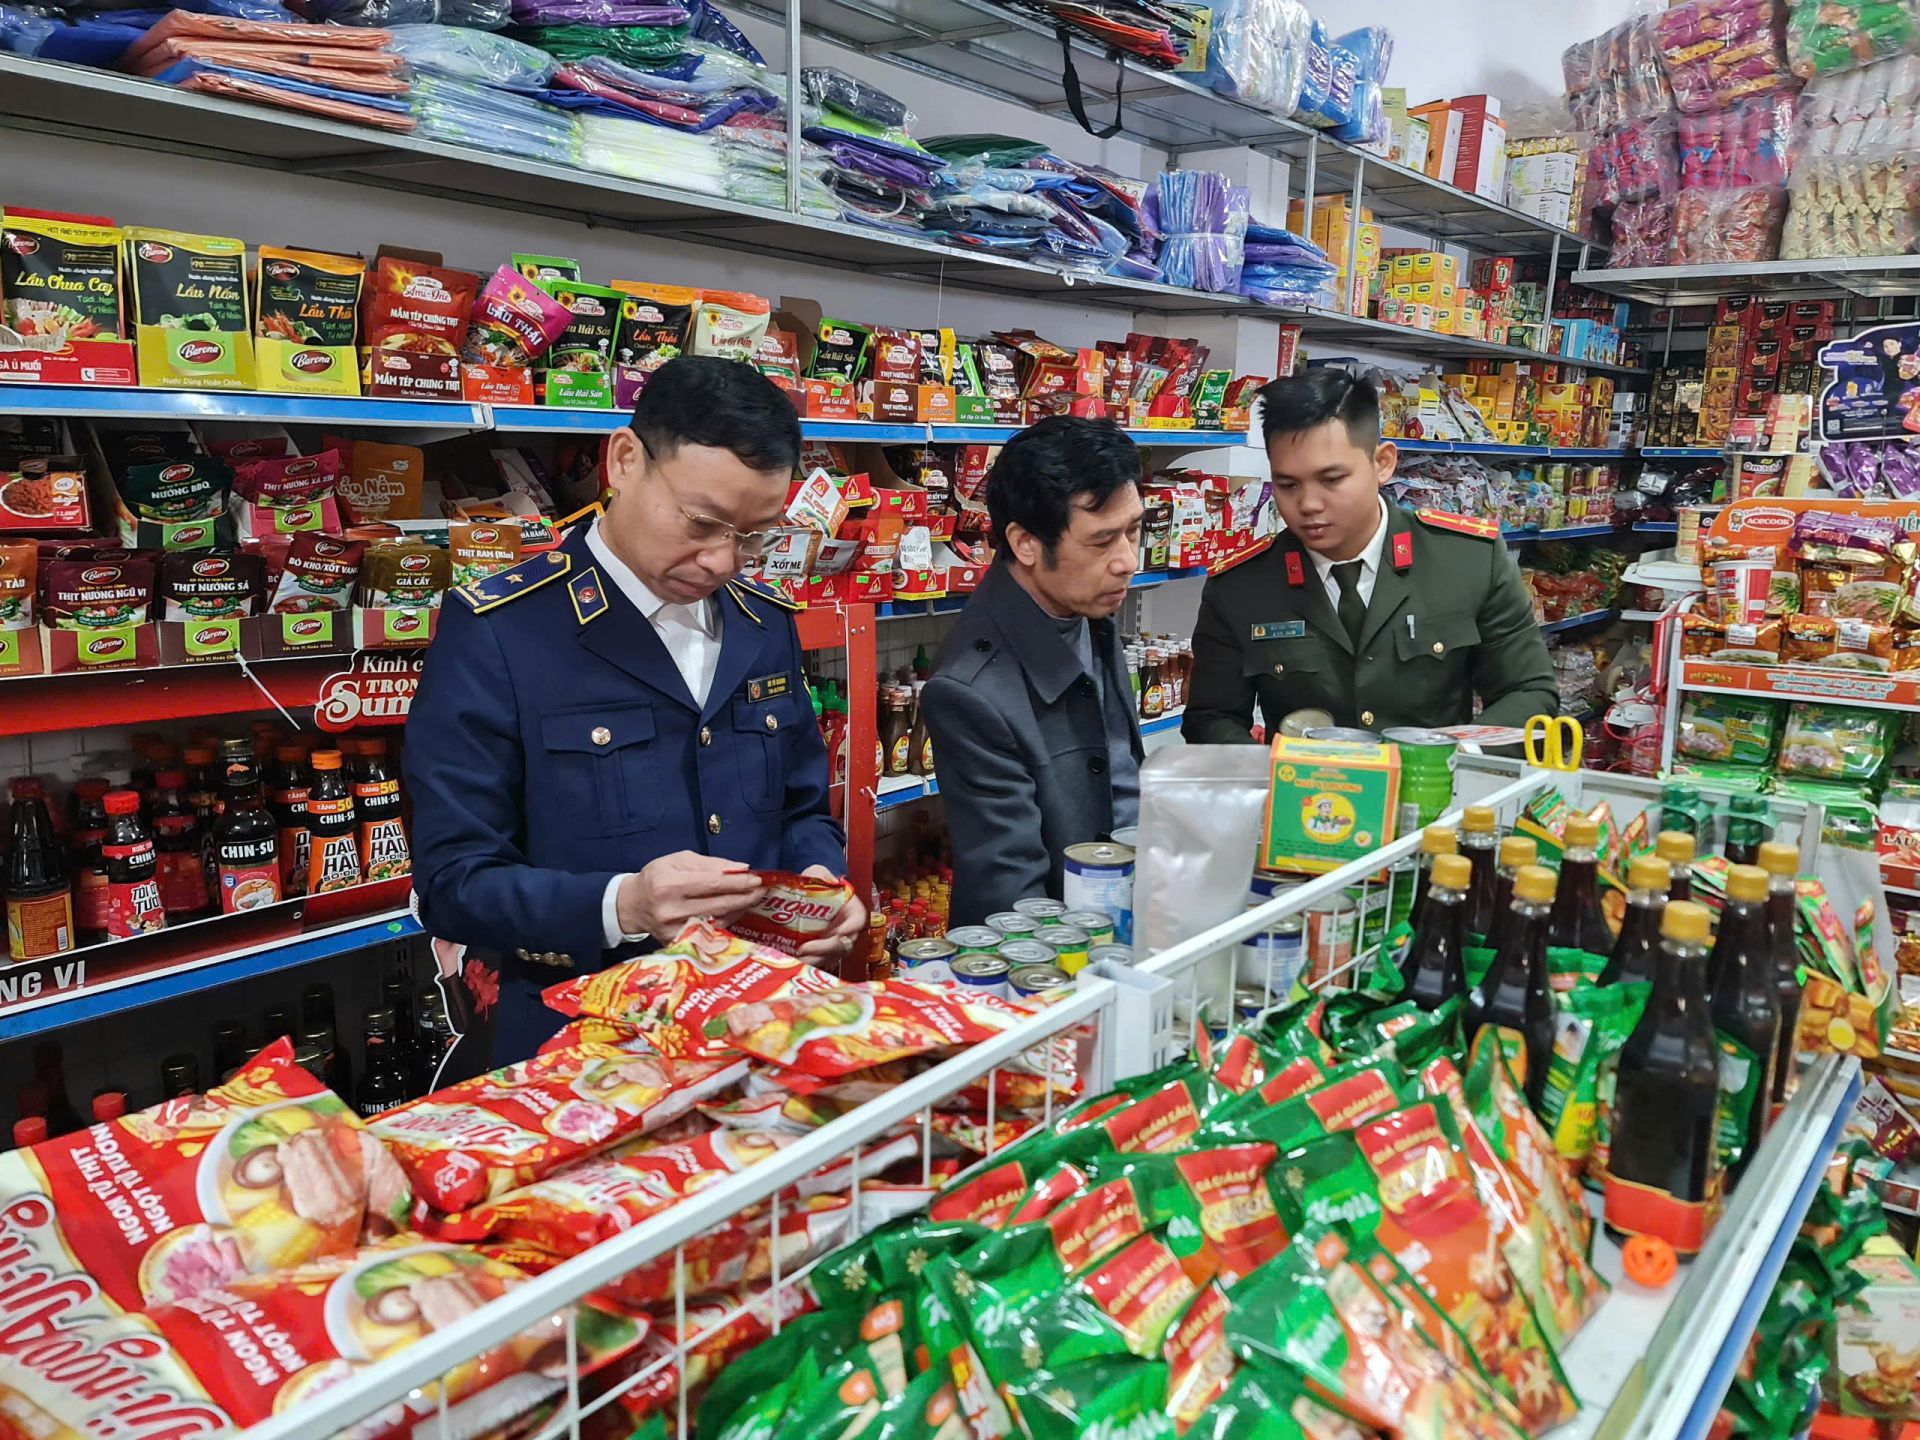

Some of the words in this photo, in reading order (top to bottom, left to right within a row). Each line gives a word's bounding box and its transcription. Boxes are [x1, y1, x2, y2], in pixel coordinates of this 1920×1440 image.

[47, 274, 86, 291] Chua
[88, 277, 115, 297] Cay
[404, 286, 451, 300] Ami-One
[181, 344, 219, 359] Barona
[293, 353, 331, 368] Barona
[190, 480, 211, 491] BBQ
[283, 513, 312, 525] Barona
[197, 561, 226, 574] Barona
[403, 557, 428, 569] Barona
[791, 560, 803, 570] ME
[5, 577, 25, 589] TÀU
[88, 569, 117, 582] Barona
[57, 591, 79, 603] THỊT
[80, 589, 114, 601] NƯỚNG
[116, 585, 134, 599] NGŨ
[172, 582, 197, 596] THỊT
[198, 581, 236, 592] NƯỚNG
[237, 579, 250, 591] SẢ
[296, 621, 323, 633] Barona
[395, 619, 419, 630] Barona
[197, 630, 227, 643] Barona
[90, 640, 125, 655] Barona
[361, 656, 408, 674] Kính
[364, 793, 400, 808] CHIN-SU
[320, 810, 355, 826] CHIN-SU
[220, 839, 275, 861] CHIN-SU
[53, 960, 86, 990] VỊ
[70, 1145, 104, 1182] THỊT
[88, 1178, 117, 1202] TỪ
[129, 1184, 175, 1235] NGỌT
[106, 1195, 148, 1246] NGON
[252, 1322, 307, 1375] NGỌT
[223, 1329, 280, 1387] NGON
